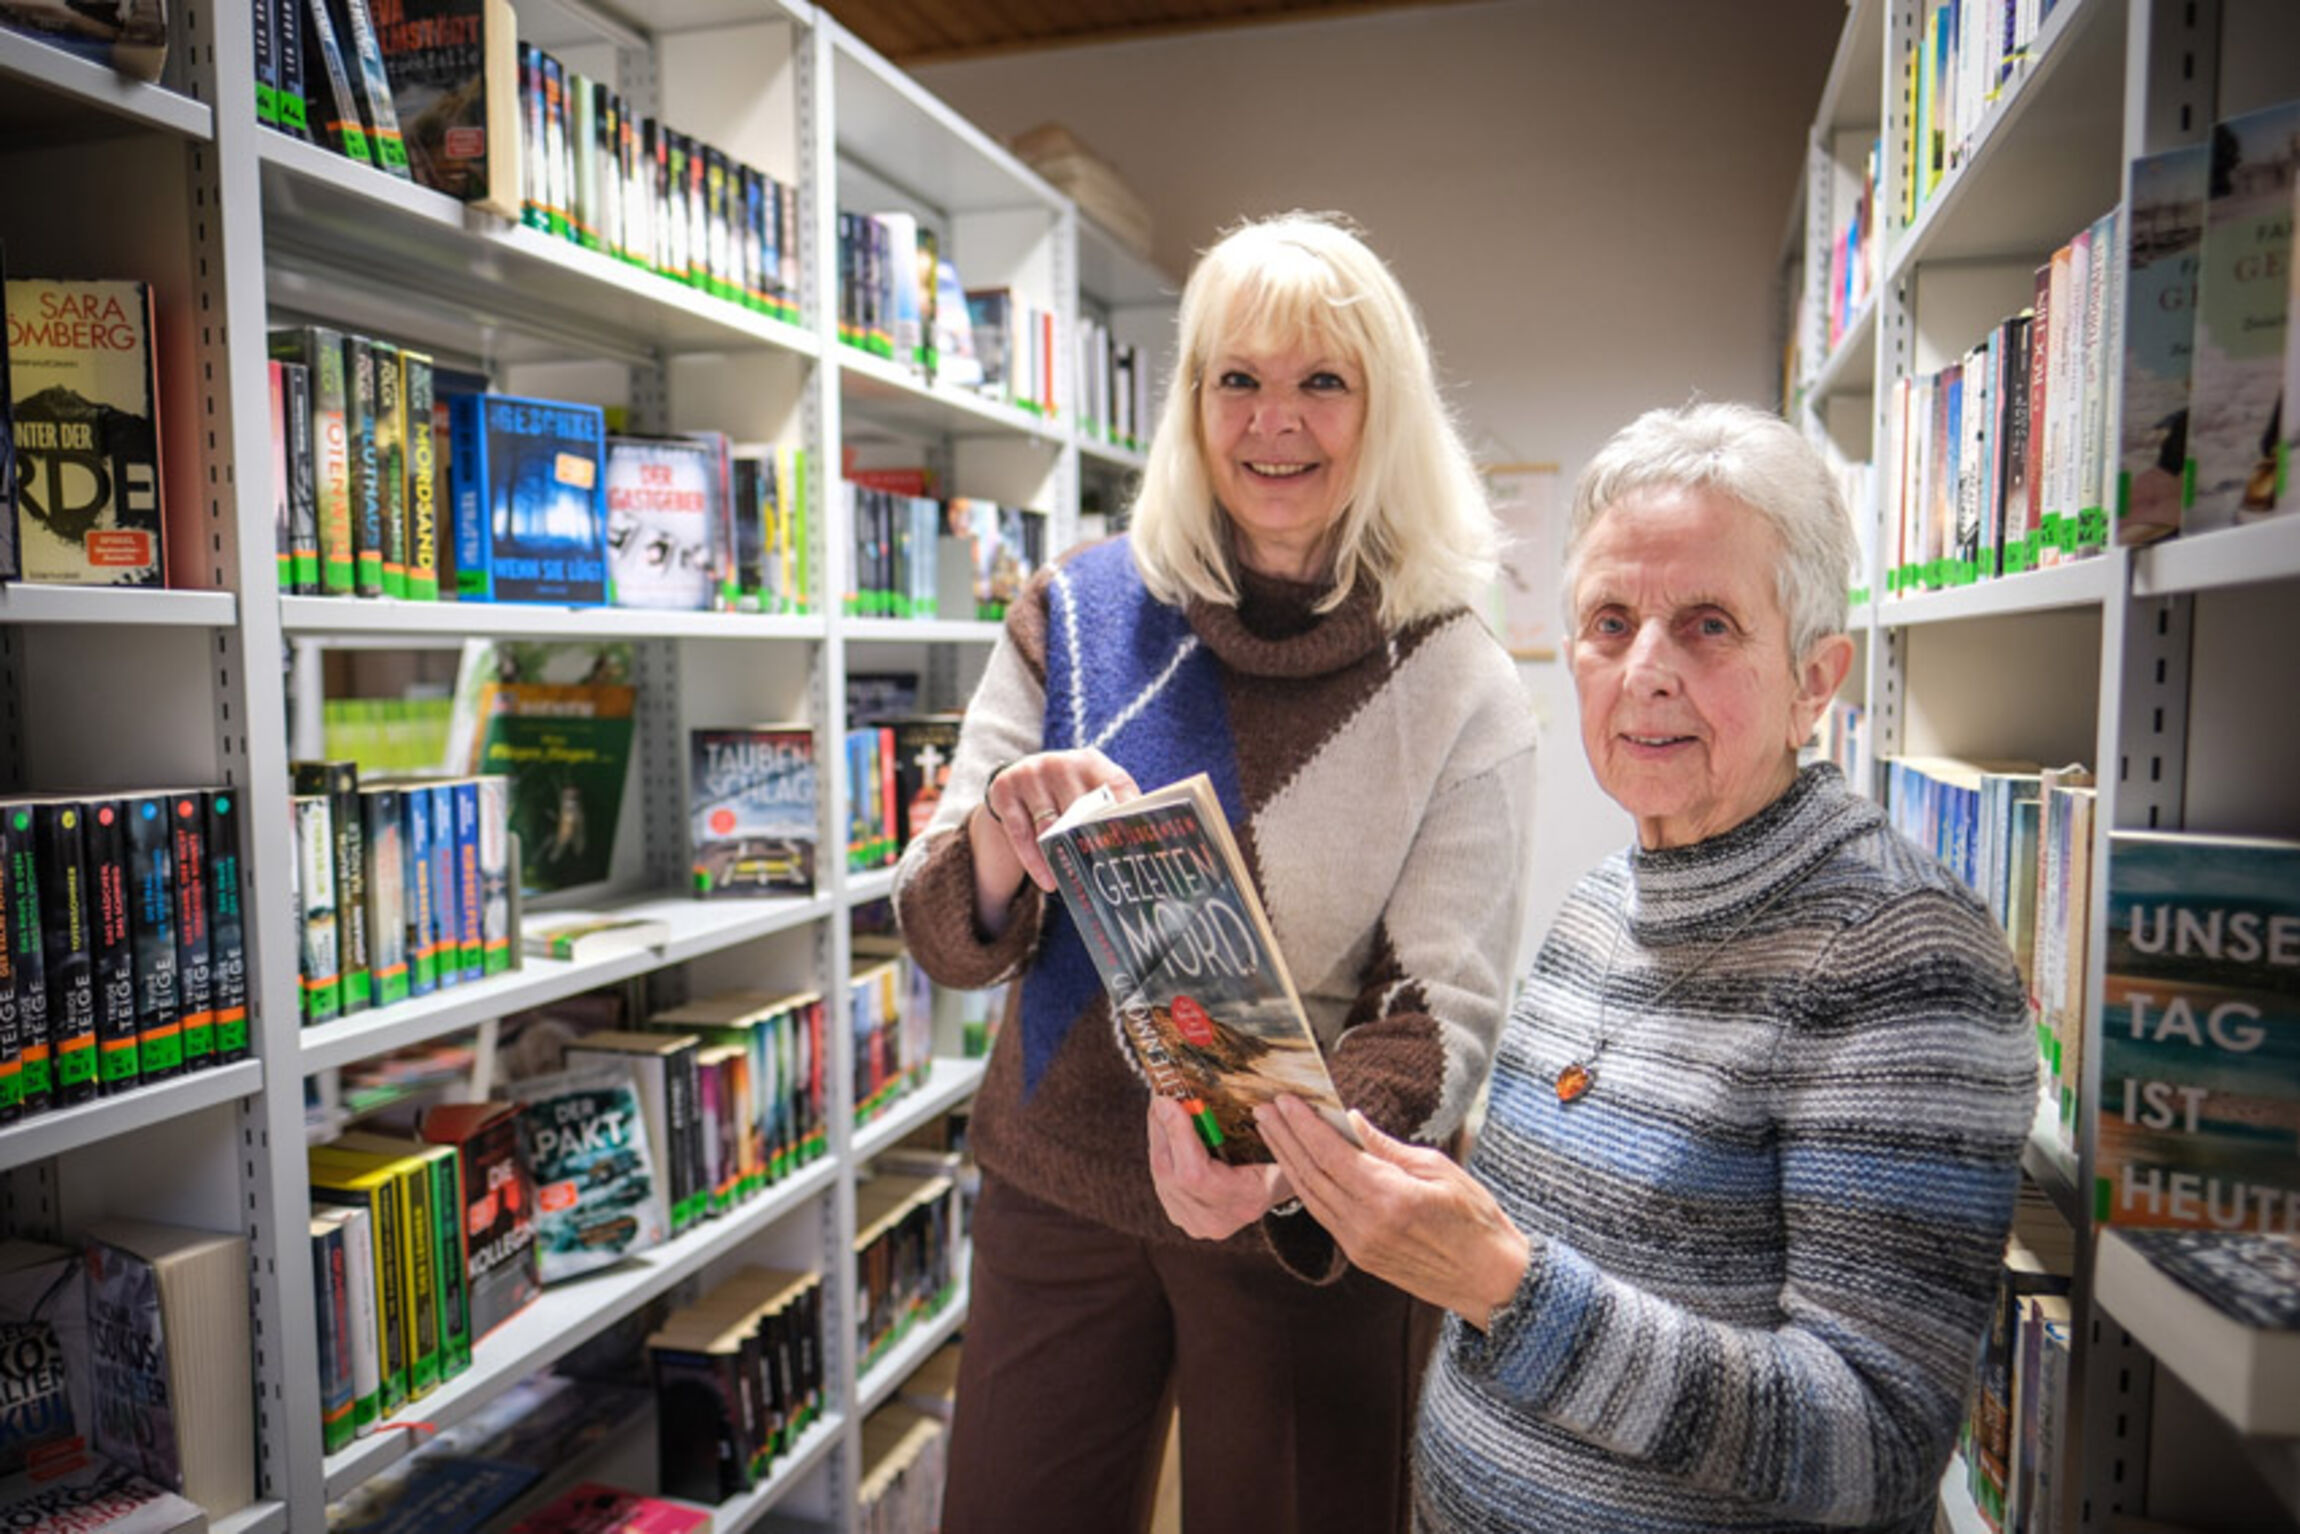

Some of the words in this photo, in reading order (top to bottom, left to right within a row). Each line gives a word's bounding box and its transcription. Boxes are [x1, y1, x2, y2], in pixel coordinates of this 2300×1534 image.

[6, 313, 136, 350] ÖMBERG
[40, 292, 126, 322] SARA
[61, 424, 93, 449] DER
[415, 423, 435, 569] MORDSAND
[706, 743, 812, 772] TAUBEN
[706, 775, 815, 803] SCHLAG
[1093, 842, 1226, 907] GEZEITEN
[1116, 897, 1260, 978] MORD
[2129, 904, 2300, 967] UNSE
[116, 967, 133, 1031] TEIGE
[156, 959, 172, 1021] TEIGE
[194, 951, 209, 1012] TEIGE
[227, 947, 242, 1006] TEIGE
[2125, 992, 2267, 1052] TAG
[555, 1099, 596, 1124] DER
[2123, 1079, 2208, 1133] IST
[534, 1111, 627, 1161] PAKT
